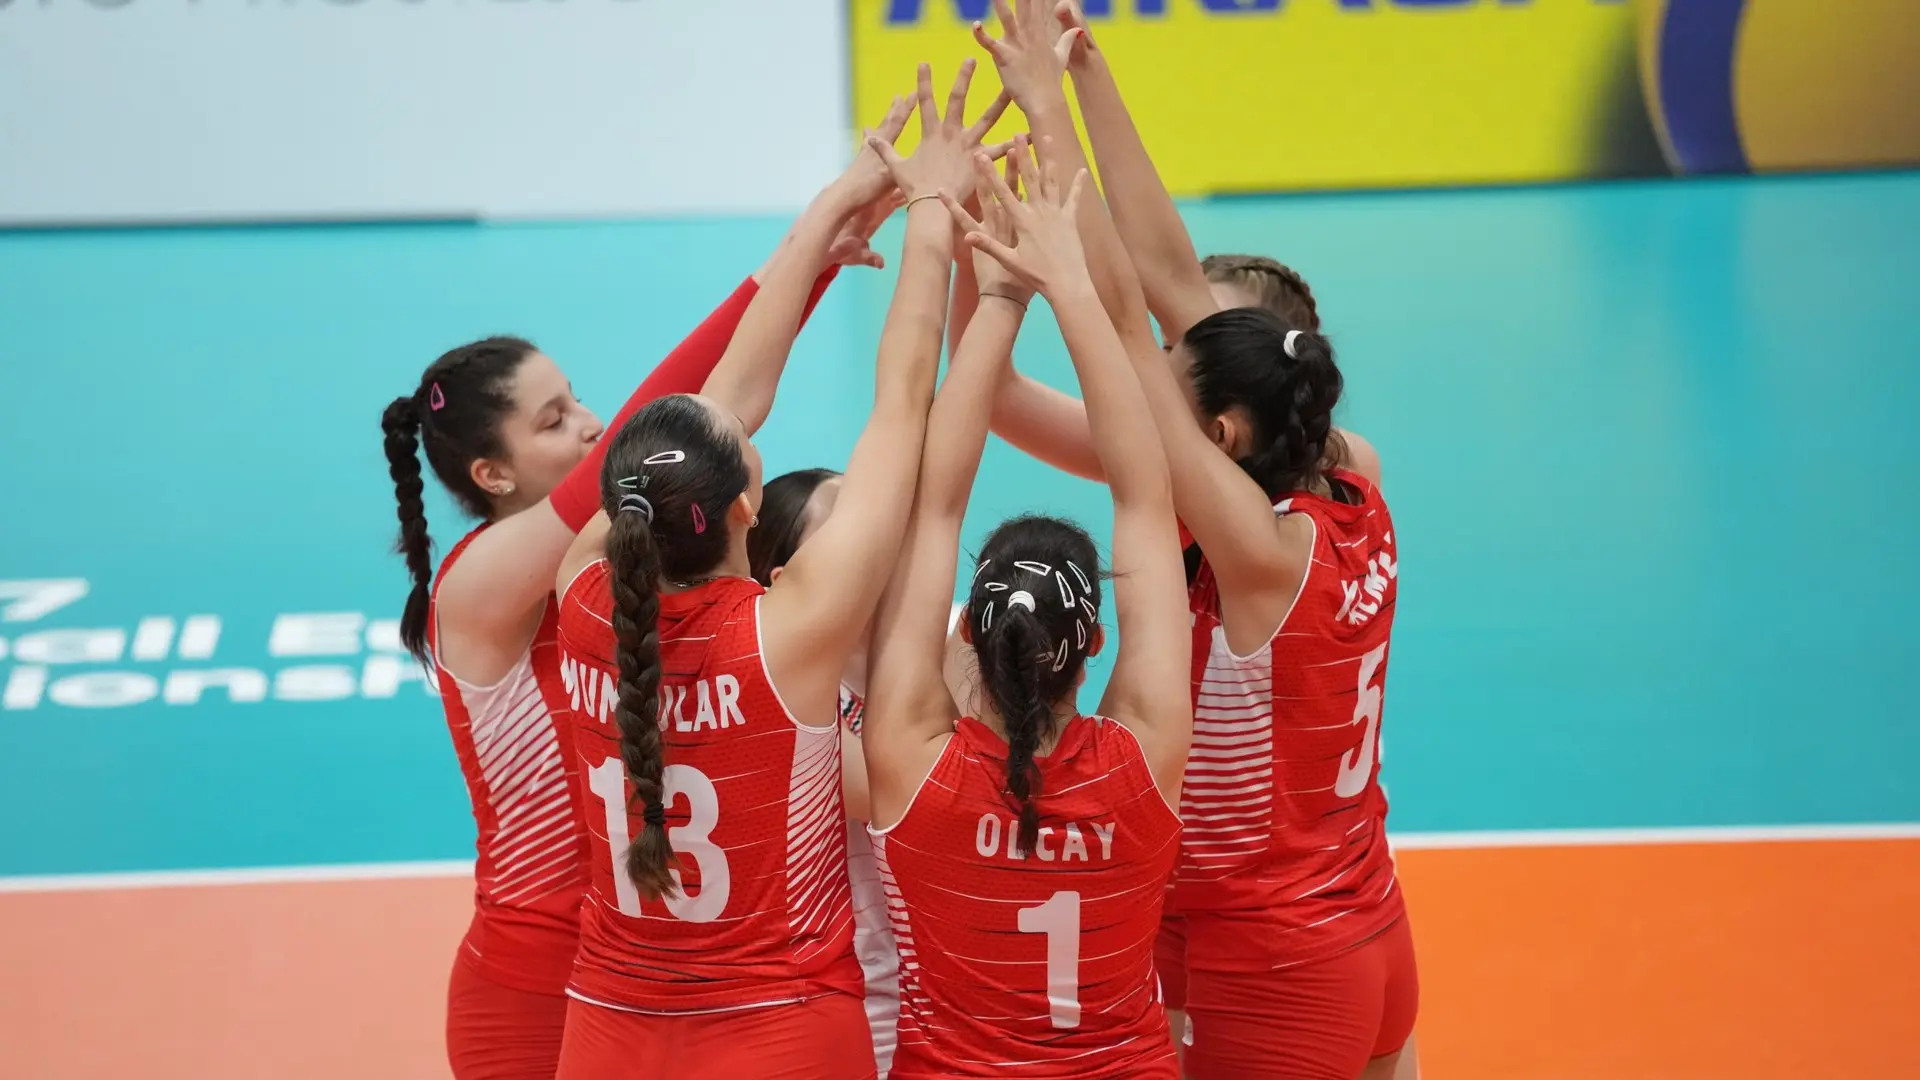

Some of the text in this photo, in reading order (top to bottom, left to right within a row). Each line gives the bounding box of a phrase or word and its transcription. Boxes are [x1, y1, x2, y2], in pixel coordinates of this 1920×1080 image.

[1334, 641, 1388, 798] 5
[588, 756, 731, 923] 13
[975, 813, 1116, 862] OLCAY
[1017, 890, 1082, 1029] 1
